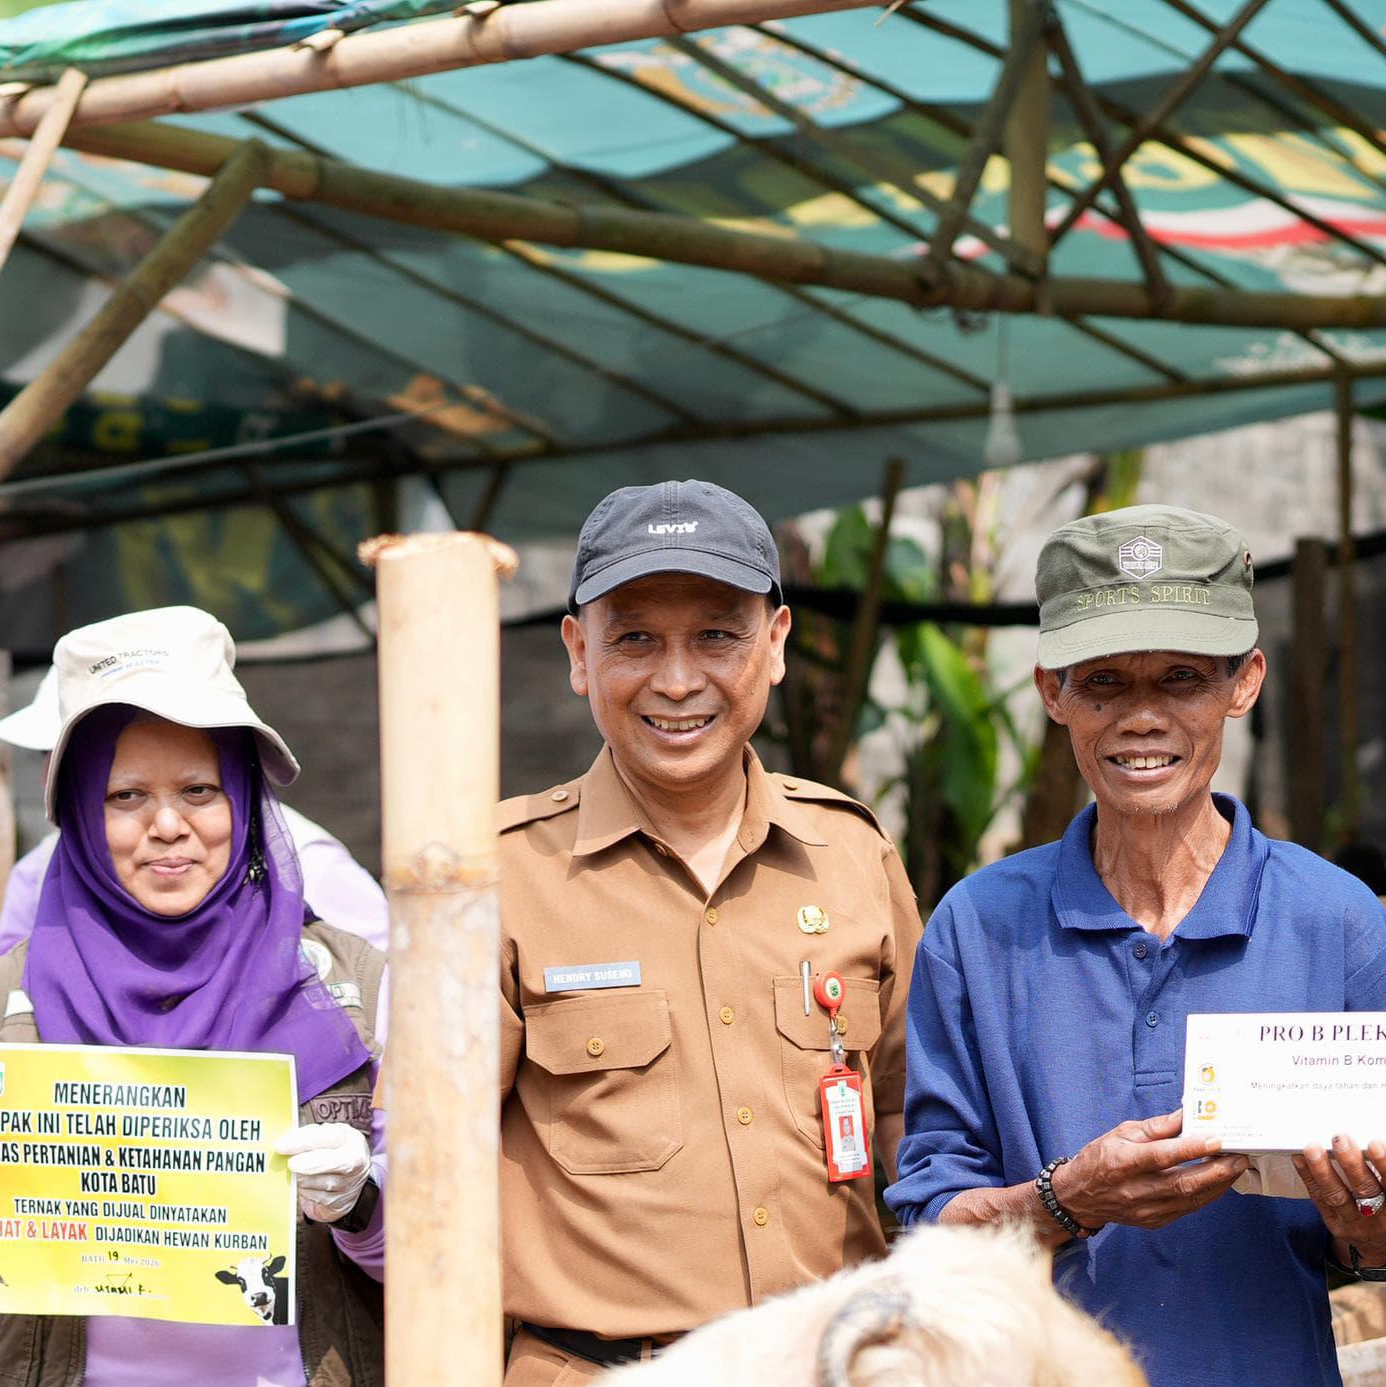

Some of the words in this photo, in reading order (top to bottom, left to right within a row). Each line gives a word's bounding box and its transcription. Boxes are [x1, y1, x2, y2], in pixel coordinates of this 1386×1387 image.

[1076, 586, 1140, 611] SPORTS
[1151, 585, 1212, 605] SPIRIT
[88, 655, 117, 674] UNITED
[117, 649, 169, 659] TRACTORS
[553, 971, 592, 984] HENDRY
[594, 968, 633, 980] SUSENO
[1260, 1025, 1304, 1041] PRO
[1312, 1025, 1324, 1041] B
[1292, 1055, 1339, 1066] Vitamin
[1344, 1055, 1353, 1066] B
[54, 1083, 185, 1108] MENERANGKAN
[1251, 1082, 1310, 1091] Meningkatkan
[1313, 1081, 1333, 1091] daya
[1335, 1081, 1358, 1089] tahan
[1362, 1081, 1377, 1089] dan
[38, 1112, 60, 1134] INI
[66, 1113, 116, 1136] TELAH
[123, 1115, 212, 1139] DIPERIKSA
[219, 1119, 261, 1141] OLEH
[24, 1144, 100, 1166] PERTANIAN
[105, 1149, 115, 1167] &
[119, 1147, 202, 1170] KETAHANAN
[206, 1151, 265, 1173] PANGAN
[81, 1172, 118, 1193] KOTA
[122, 1173, 156, 1195] BATU
[14, 1198, 61, 1215] TERNAK
[65, 1201, 98, 1217] YANG
[103, 1202, 146, 1219] DIJUAL
[149, 1205, 227, 1223] DINYATAKAN
[27, 1220, 37, 1239] &
[42, 1221, 87, 1240] LAYAK
[95, 1226, 160, 1245] DIJADIKAN
[164, 1231, 209, 1247] HEWAN
[214, 1233, 267, 1250] KURBAN
[108, 1251, 119, 1261] 19
